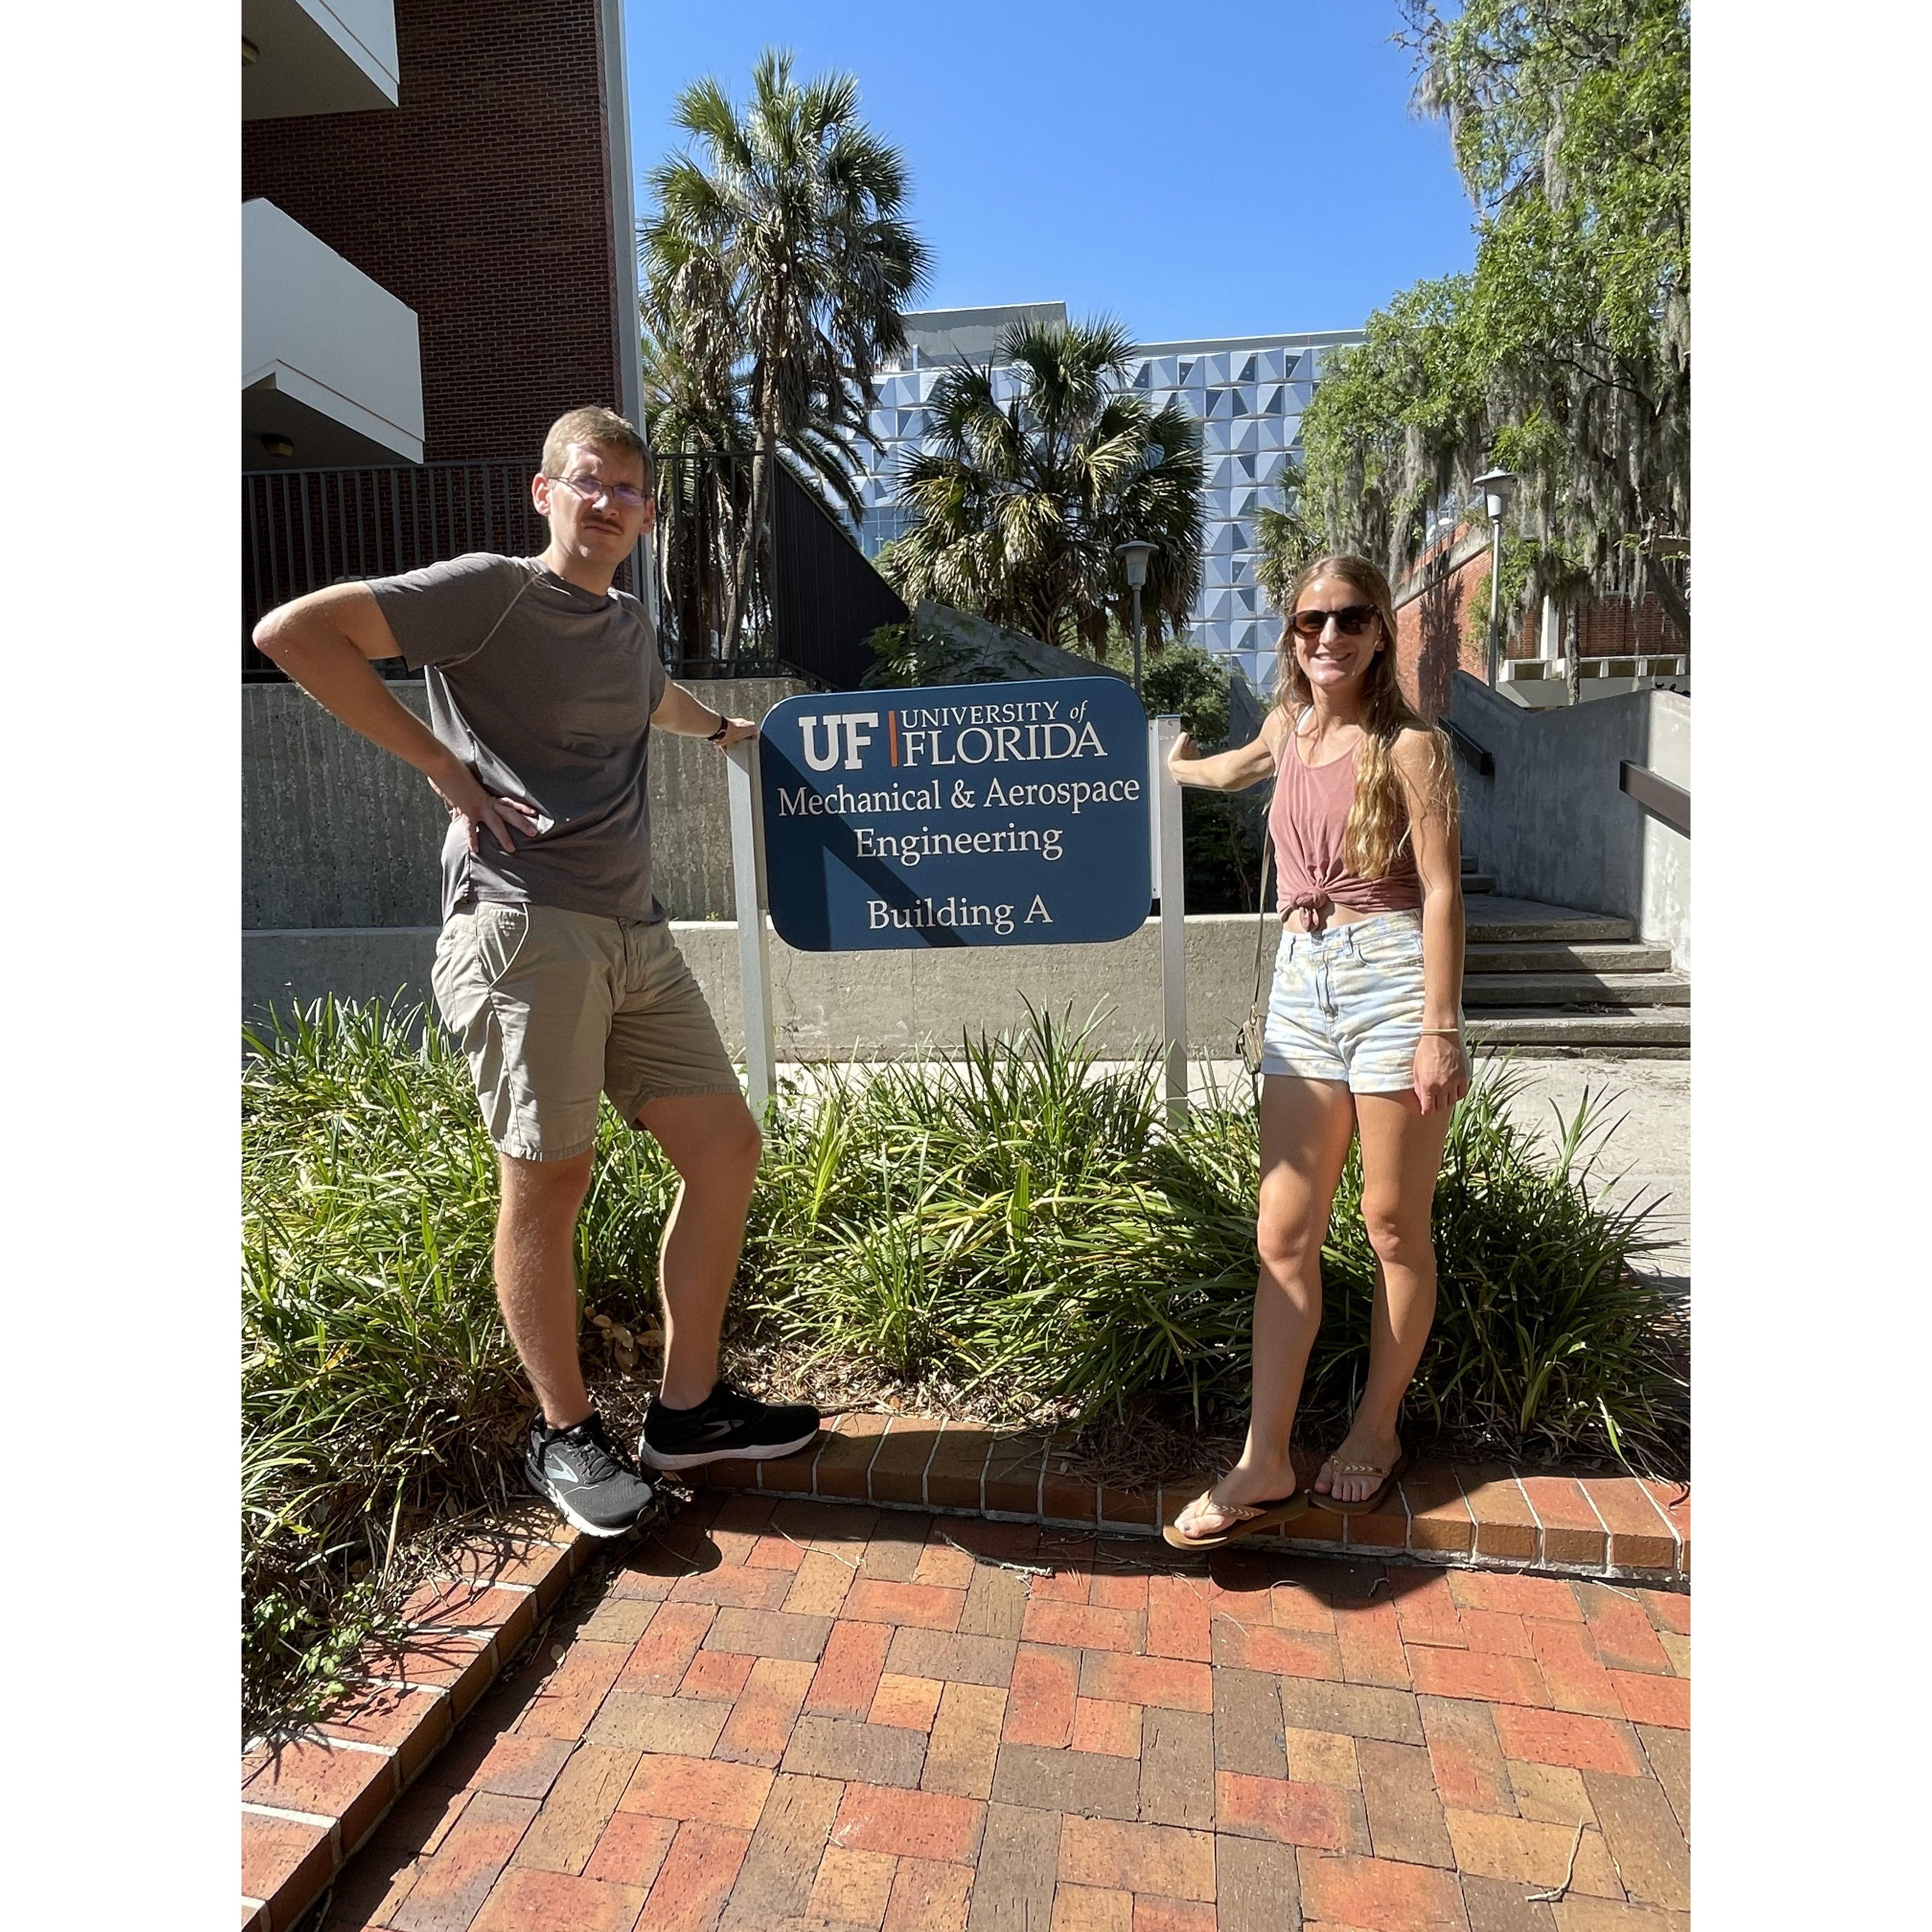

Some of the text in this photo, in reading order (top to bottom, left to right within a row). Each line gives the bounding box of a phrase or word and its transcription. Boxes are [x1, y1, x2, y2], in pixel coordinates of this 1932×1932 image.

[900, 699, 1089, 728] UNIVERSITY of
[797, 712, 879, 771] UF
[901, 720, 1108, 767] FLORIDA
[777, 777, 1140, 817] Mechanical & Aerospace
[852, 822, 1064, 867] Engineering
[866, 894, 1054, 936] Building A
